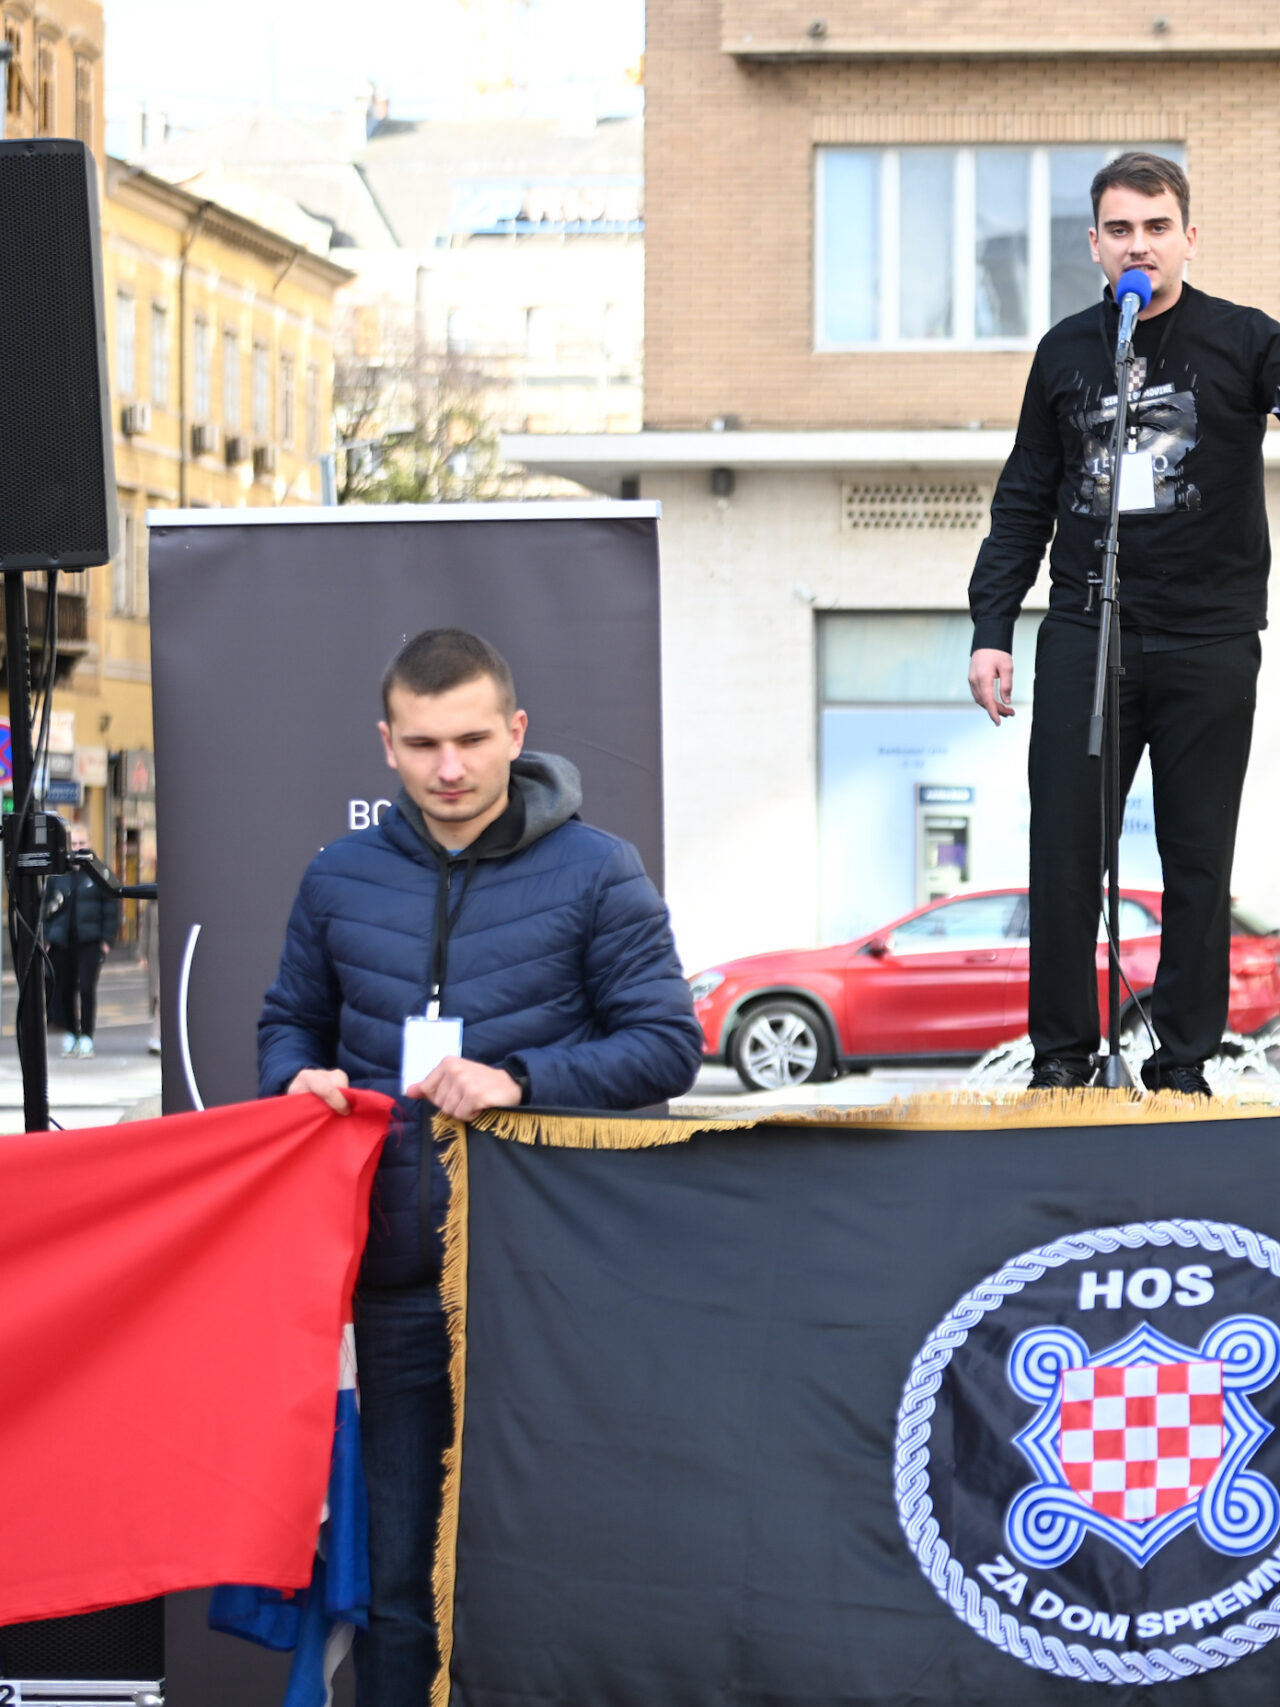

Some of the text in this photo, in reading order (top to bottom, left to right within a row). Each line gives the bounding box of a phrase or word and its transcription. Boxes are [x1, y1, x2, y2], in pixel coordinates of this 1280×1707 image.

[1078, 1264, 1216, 1310] HOS
[977, 1555, 1031, 1606] ZA
[1029, 1589, 1131, 1641] DOM
